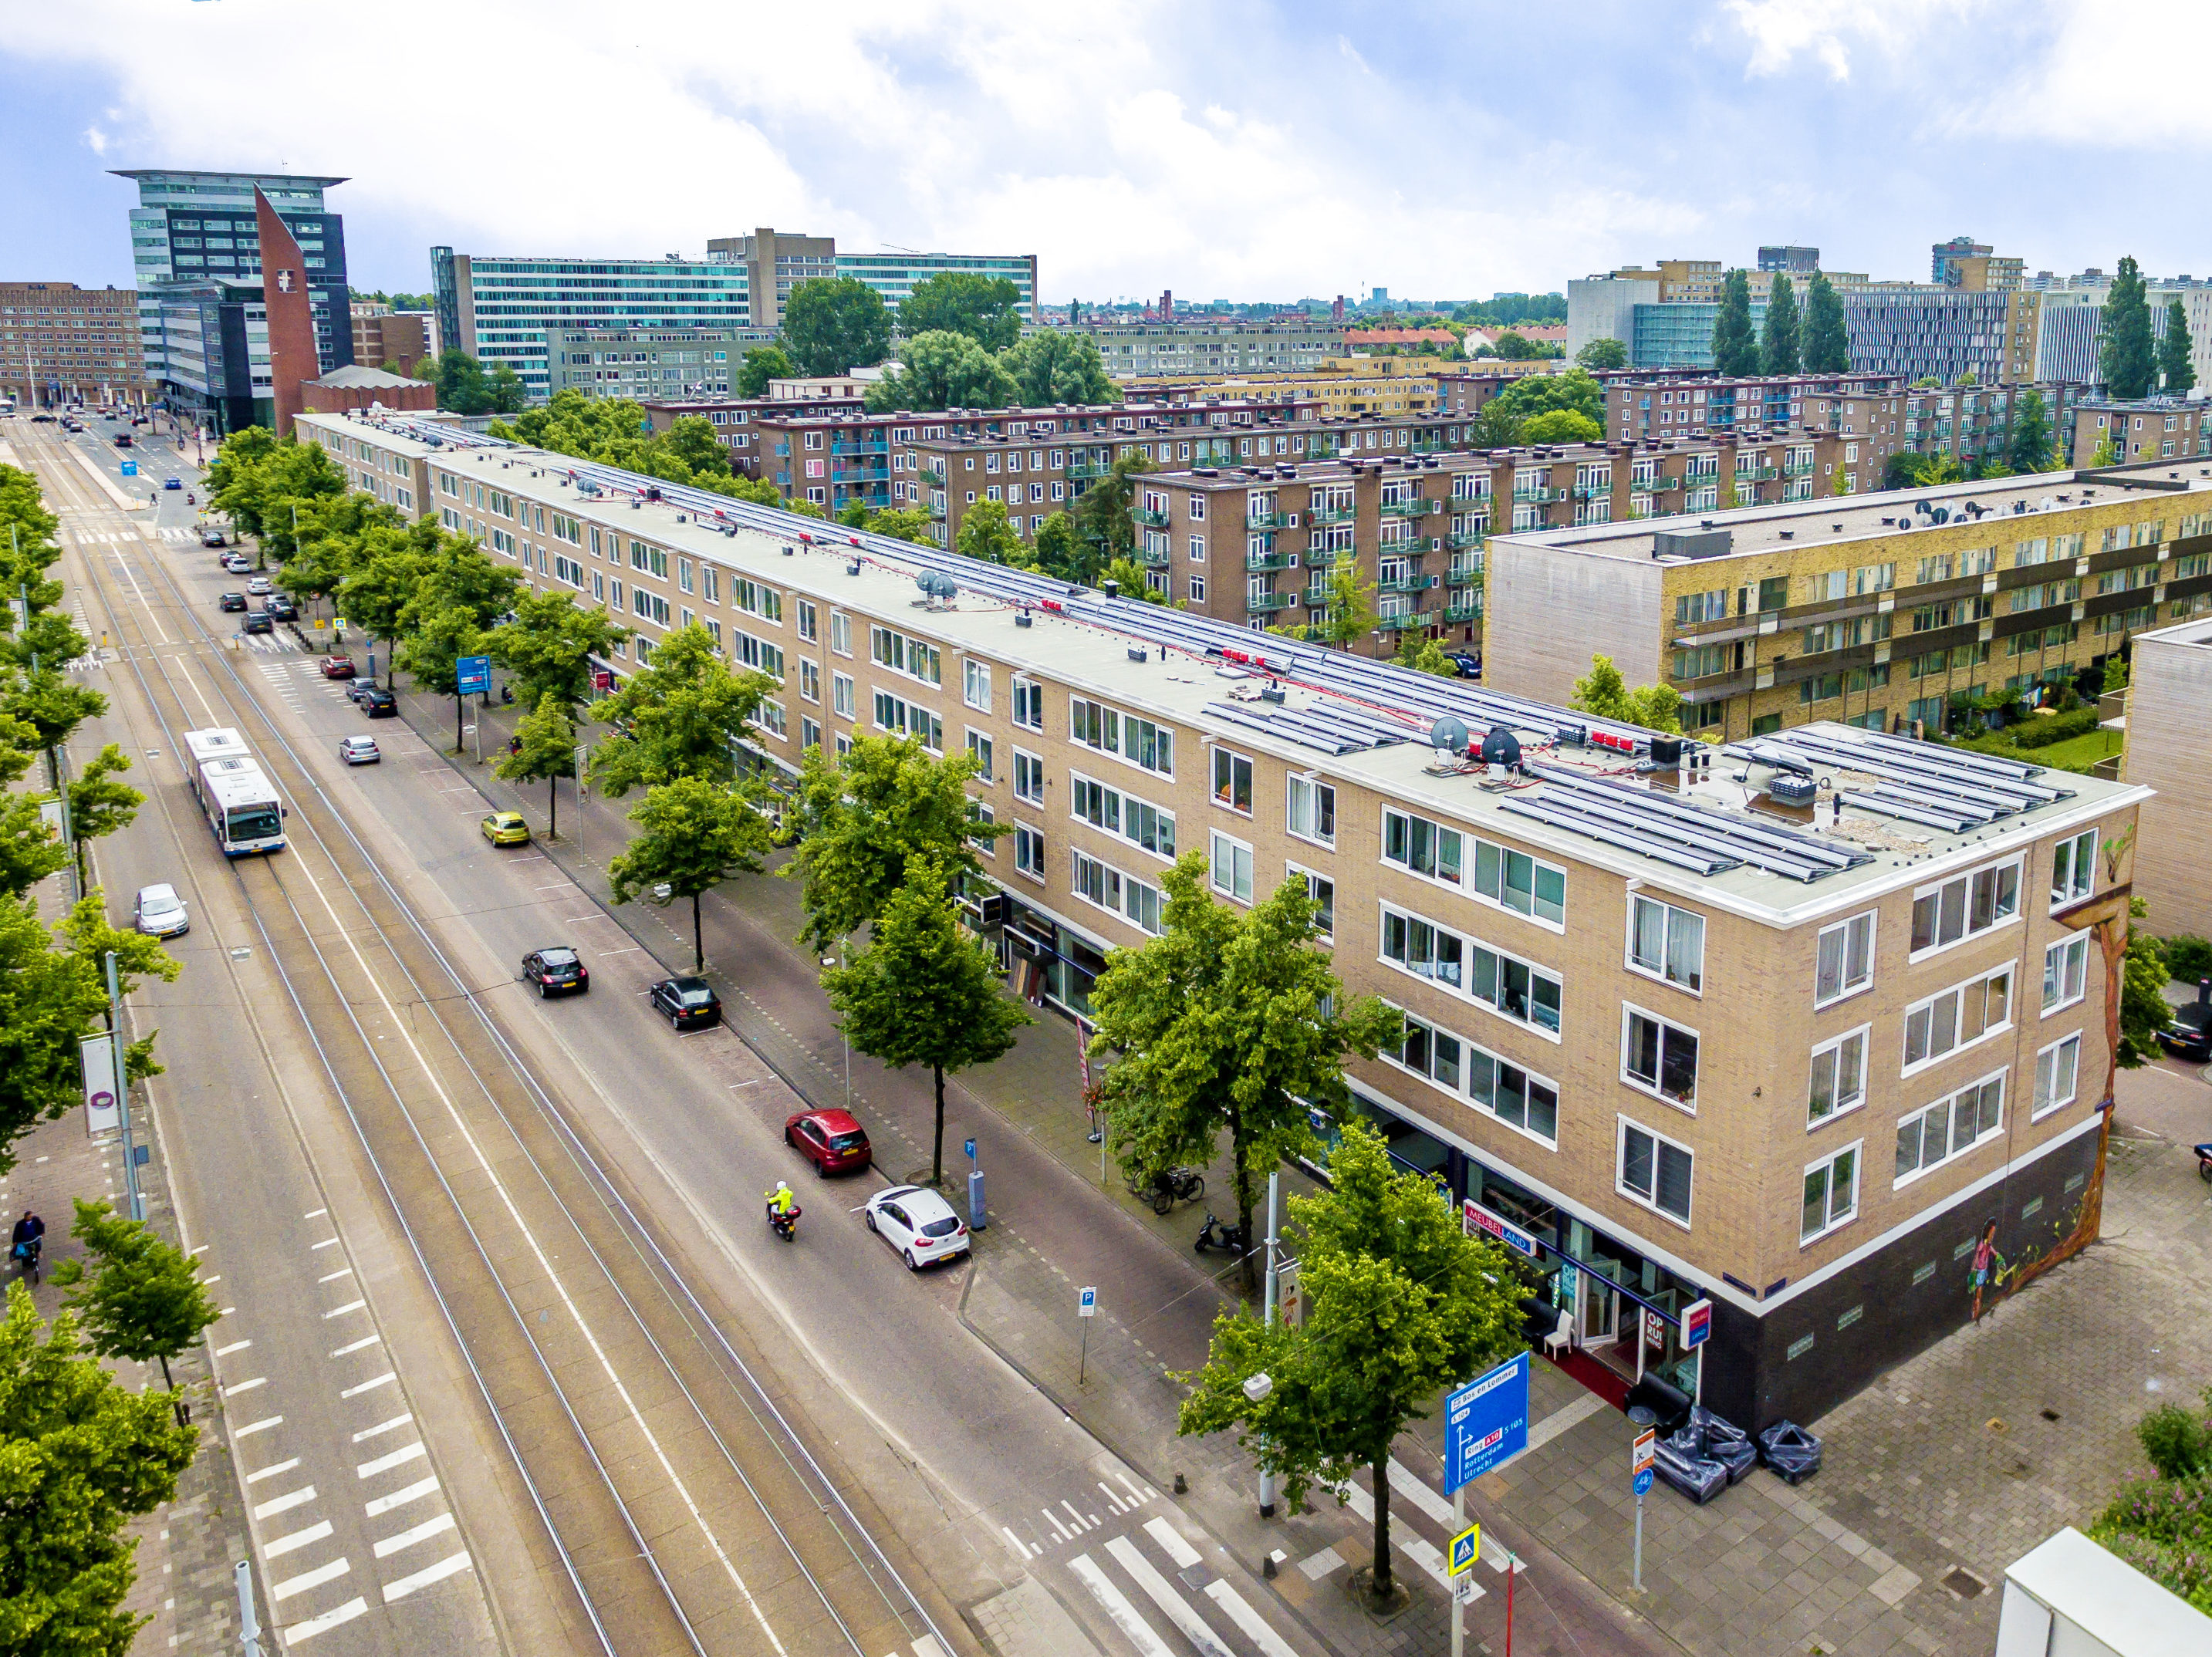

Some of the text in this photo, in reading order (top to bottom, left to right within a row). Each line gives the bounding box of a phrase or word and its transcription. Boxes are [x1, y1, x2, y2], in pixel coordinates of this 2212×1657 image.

[1469, 1210, 1526, 1248] MEUBELLAND
[1647, 1312, 1663, 1328] OP
[1647, 1324, 1663, 1341] RUI
[1463, 1368, 1515, 1402] Bos en Lommer
[1467, 1443, 1483, 1455] Ring
[1486, 1431, 1499, 1445] A10
[1511, 1417, 1523, 1430] 105
[1464, 1442, 1504, 1470] Rotterdam
[1464, 1457, 1492, 1480] Utrecht
